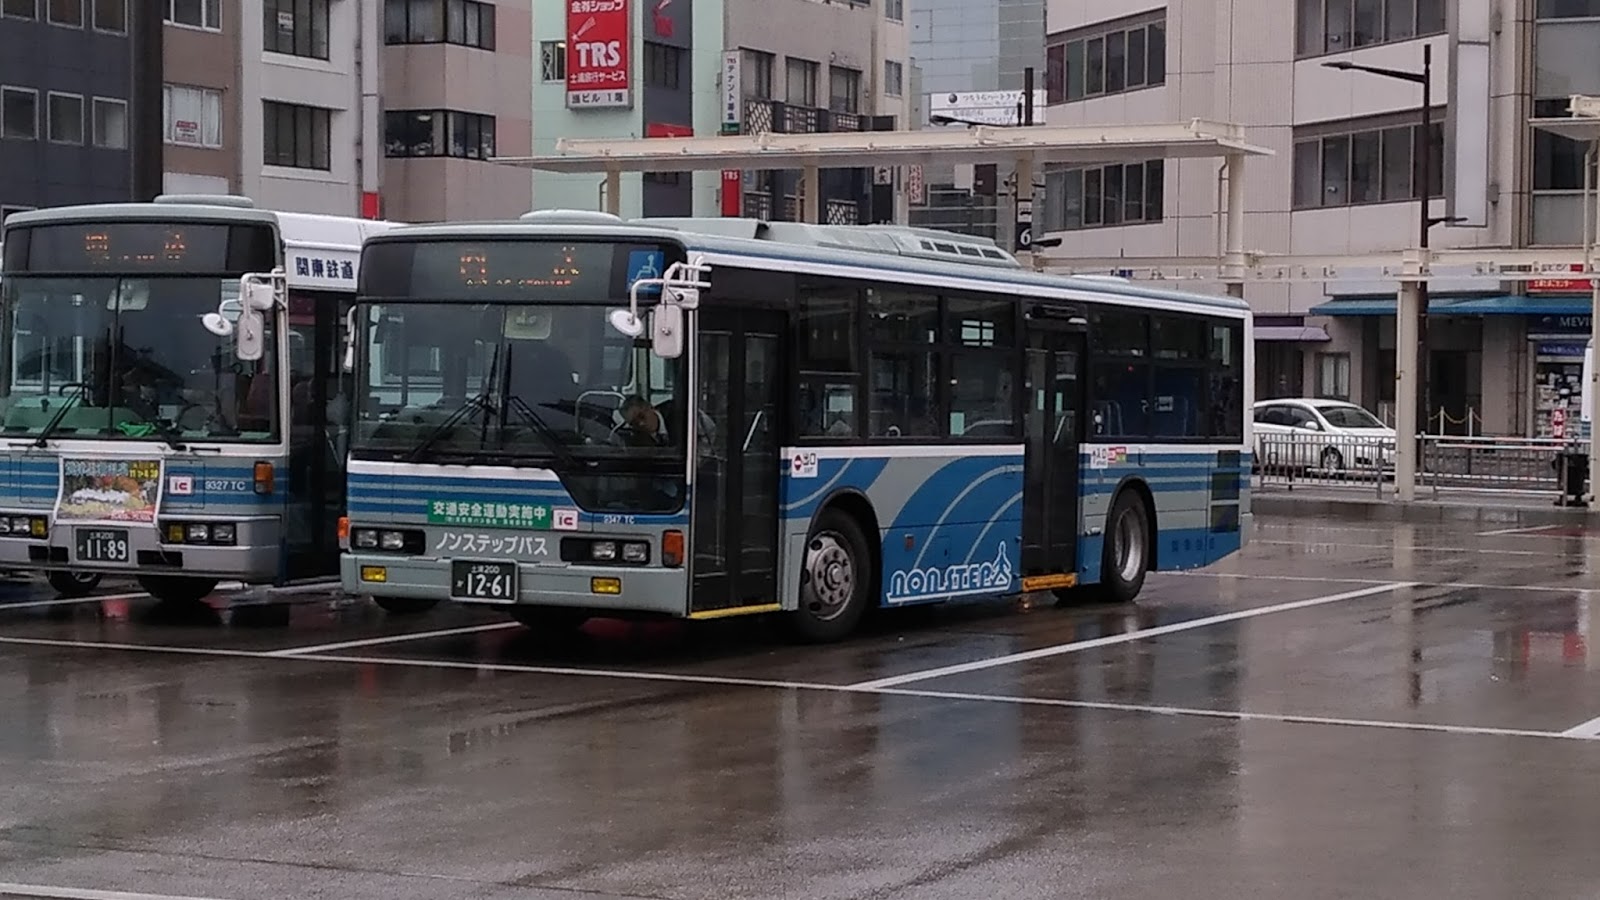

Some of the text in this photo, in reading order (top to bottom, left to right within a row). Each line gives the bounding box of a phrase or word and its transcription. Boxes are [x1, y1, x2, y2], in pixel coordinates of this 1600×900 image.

[575, 41, 620, 67] TRS
[723, 171, 738, 180] TRS
[1020, 229, 1031, 246] 6
[296, 257, 354, 280] 関東鉄道
[1560, 316, 1593, 327] MEVI
[205, 481, 246, 491] 9327 TC
[433, 501, 546, 520] 交通安全運動実施中
[435, 532, 548, 555] ノンステップバス
